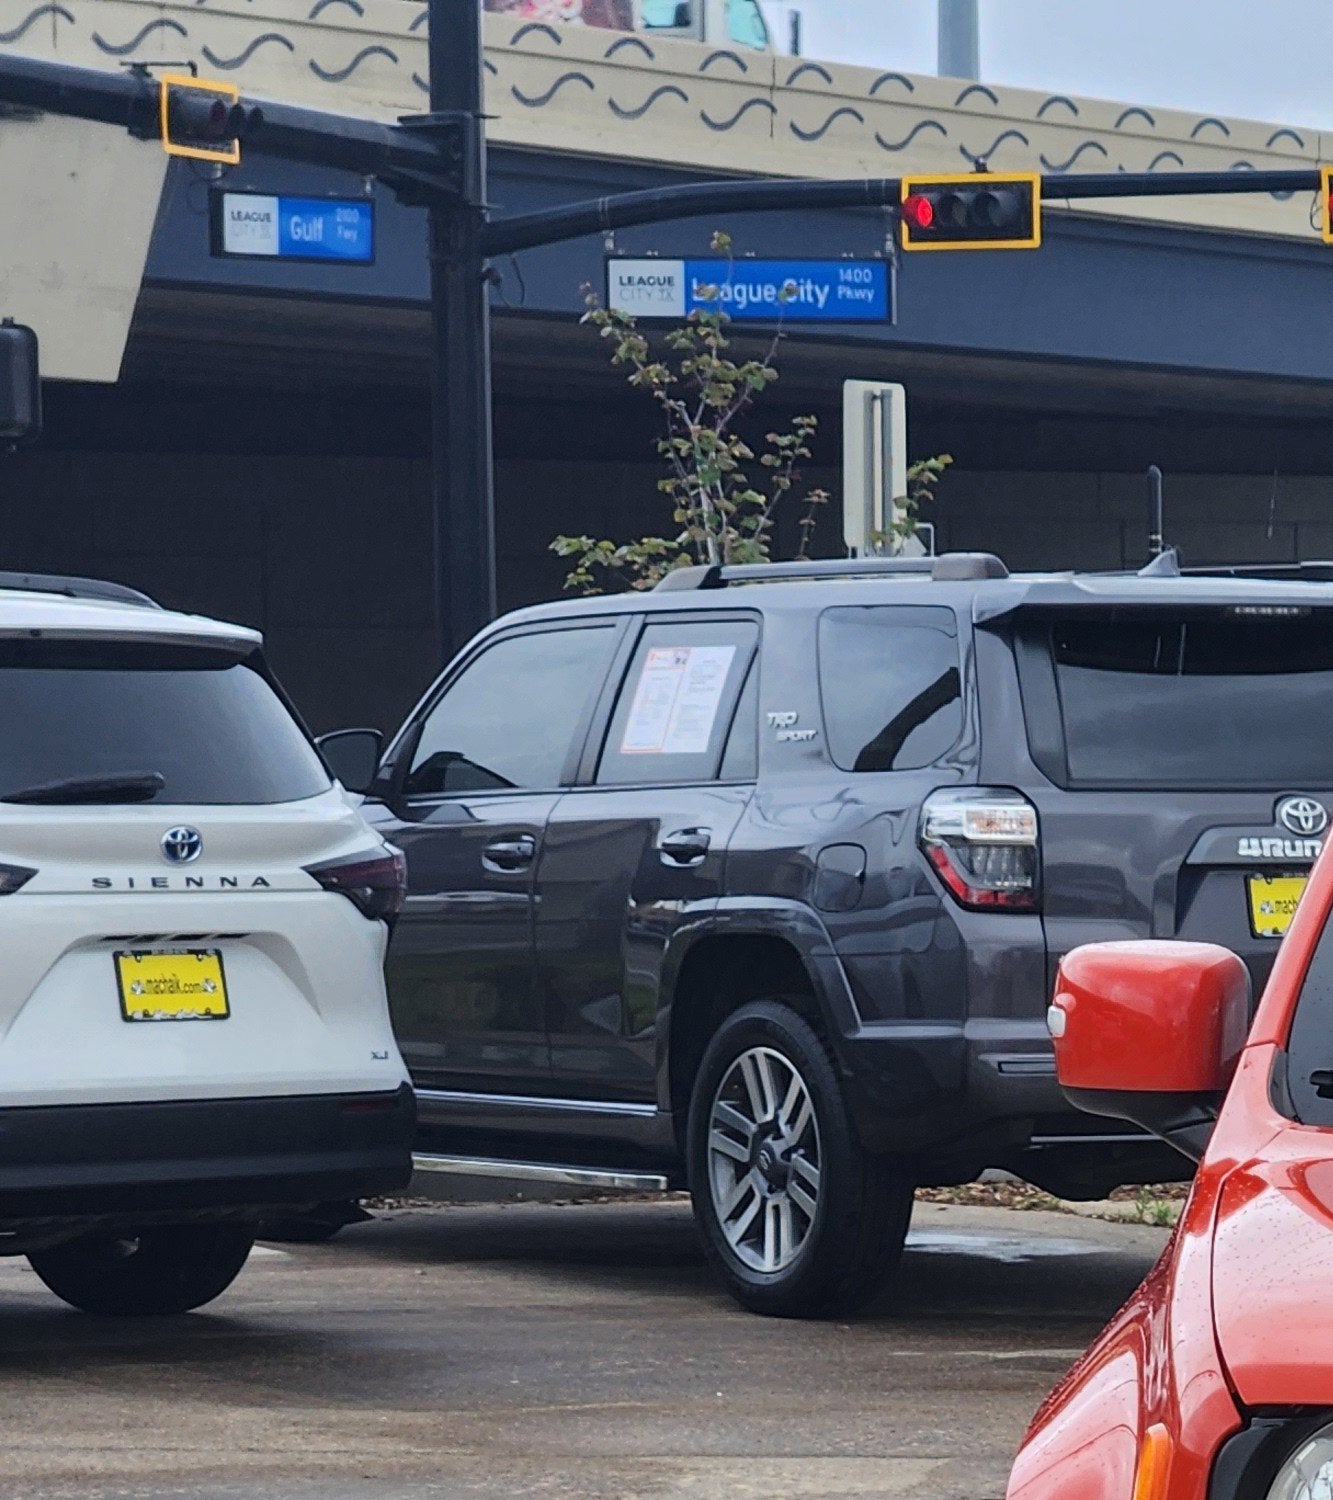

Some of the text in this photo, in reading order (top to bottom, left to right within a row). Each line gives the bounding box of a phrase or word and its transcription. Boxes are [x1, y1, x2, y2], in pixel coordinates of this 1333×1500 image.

[231, 211, 271, 222] LEAGUE
[290, 215, 324, 242] Gulf
[619, 275, 675, 287] LEAGUE
[839, 269, 873, 283] 1400
[837, 286, 875, 302] Pkwy
[92, 876, 272, 889] SIENNA
